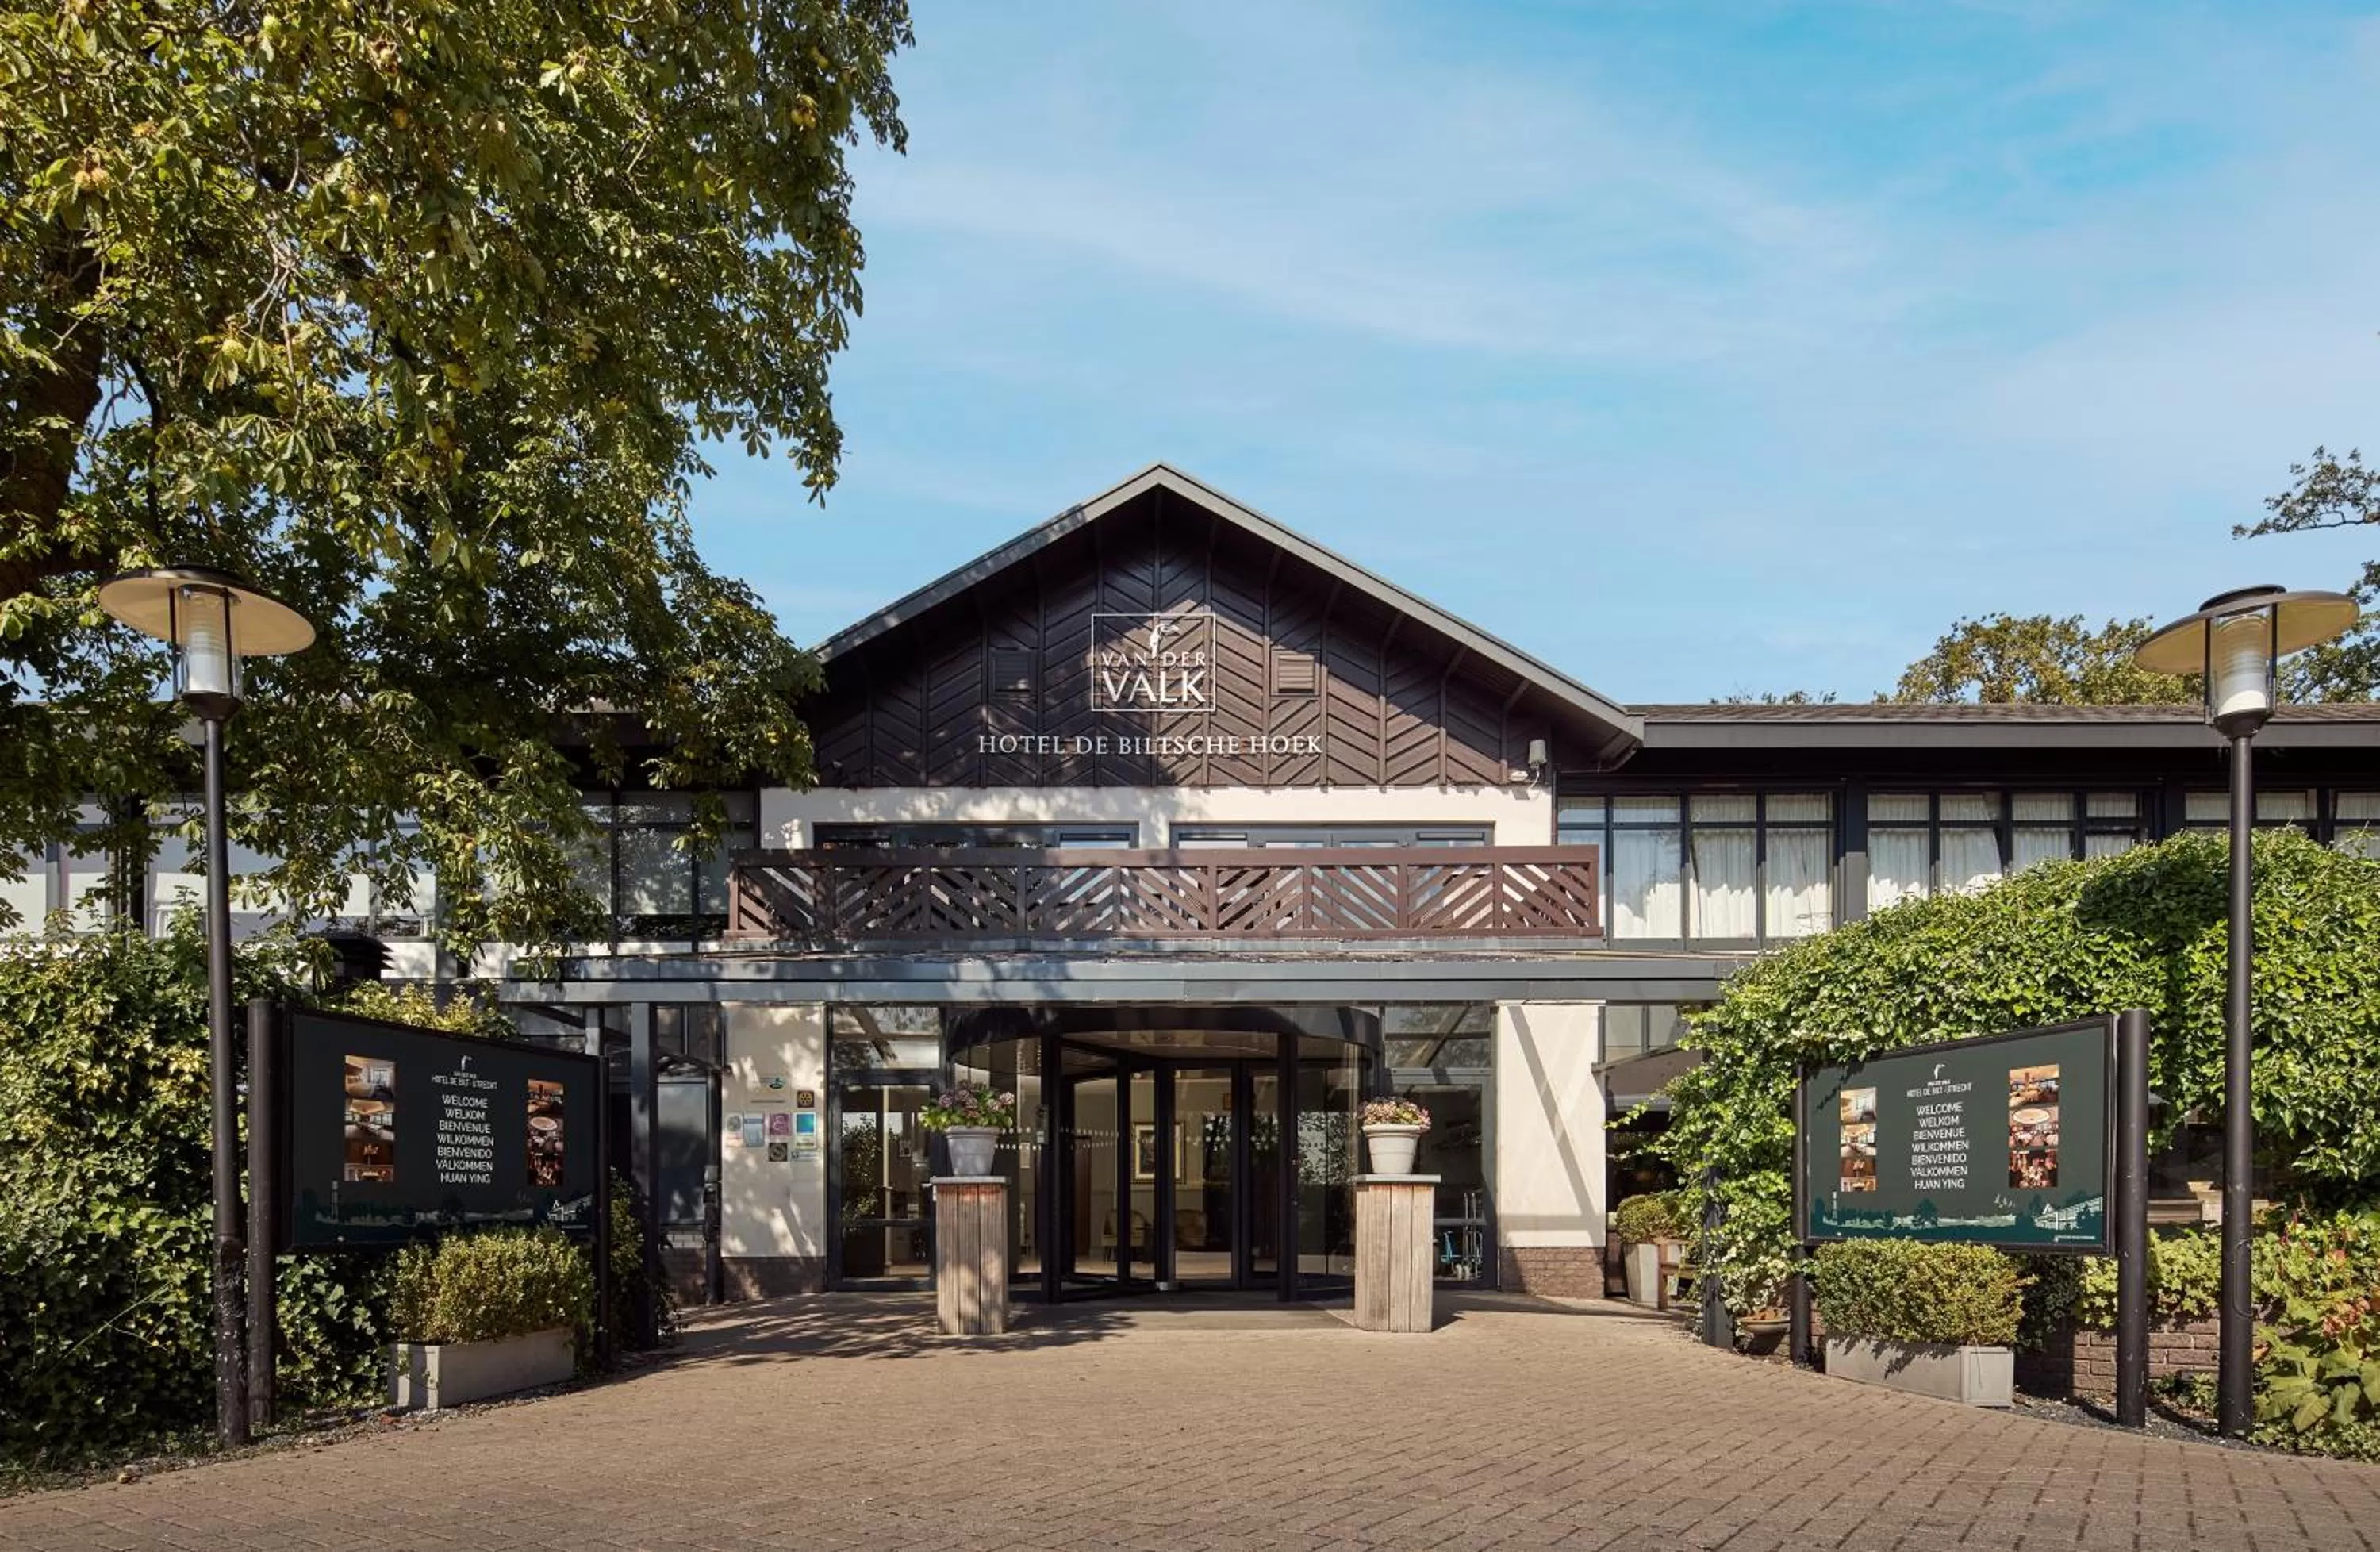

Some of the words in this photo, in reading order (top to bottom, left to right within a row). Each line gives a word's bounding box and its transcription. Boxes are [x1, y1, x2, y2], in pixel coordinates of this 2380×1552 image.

[1101, 651, 1147, 667] VAN
[1163, 651, 1206, 667] DER
[1101, 670, 1207, 702] VALK
[979, 734, 1065, 754] HOTEL
[1075, 735, 1109, 755] DE
[1119, 735, 1239, 754] BILTSCHE
[1250, 735, 1322, 754] HOEK
[442, 1094, 489, 1108] WELCOME
[444, 1108, 486, 1120] WELKOM
[1916, 1101, 1964, 1116] WELCOME
[439, 1120, 491, 1134] BIENVENUE
[1917, 1115, 1960, 1128] WELKOM
[436, 1132, 495, 1147] WILKOMMEN
[1913, 1127, 1965, 1140] BIENVENUE
[437, 1146, 493, 1159] BIENVENIDO
[1910, 1139, 1970, 1153] WILKOMMEN
[1911, 1152, 1967, 1166] BIENVENIDO
[440, 1172, 468, 1183] HUAN
[468, 1174, 490, 1185] YING
[1914, 1178, 1941, 1189] HUAN
[1941, 1177, 1966, 1189] YING
